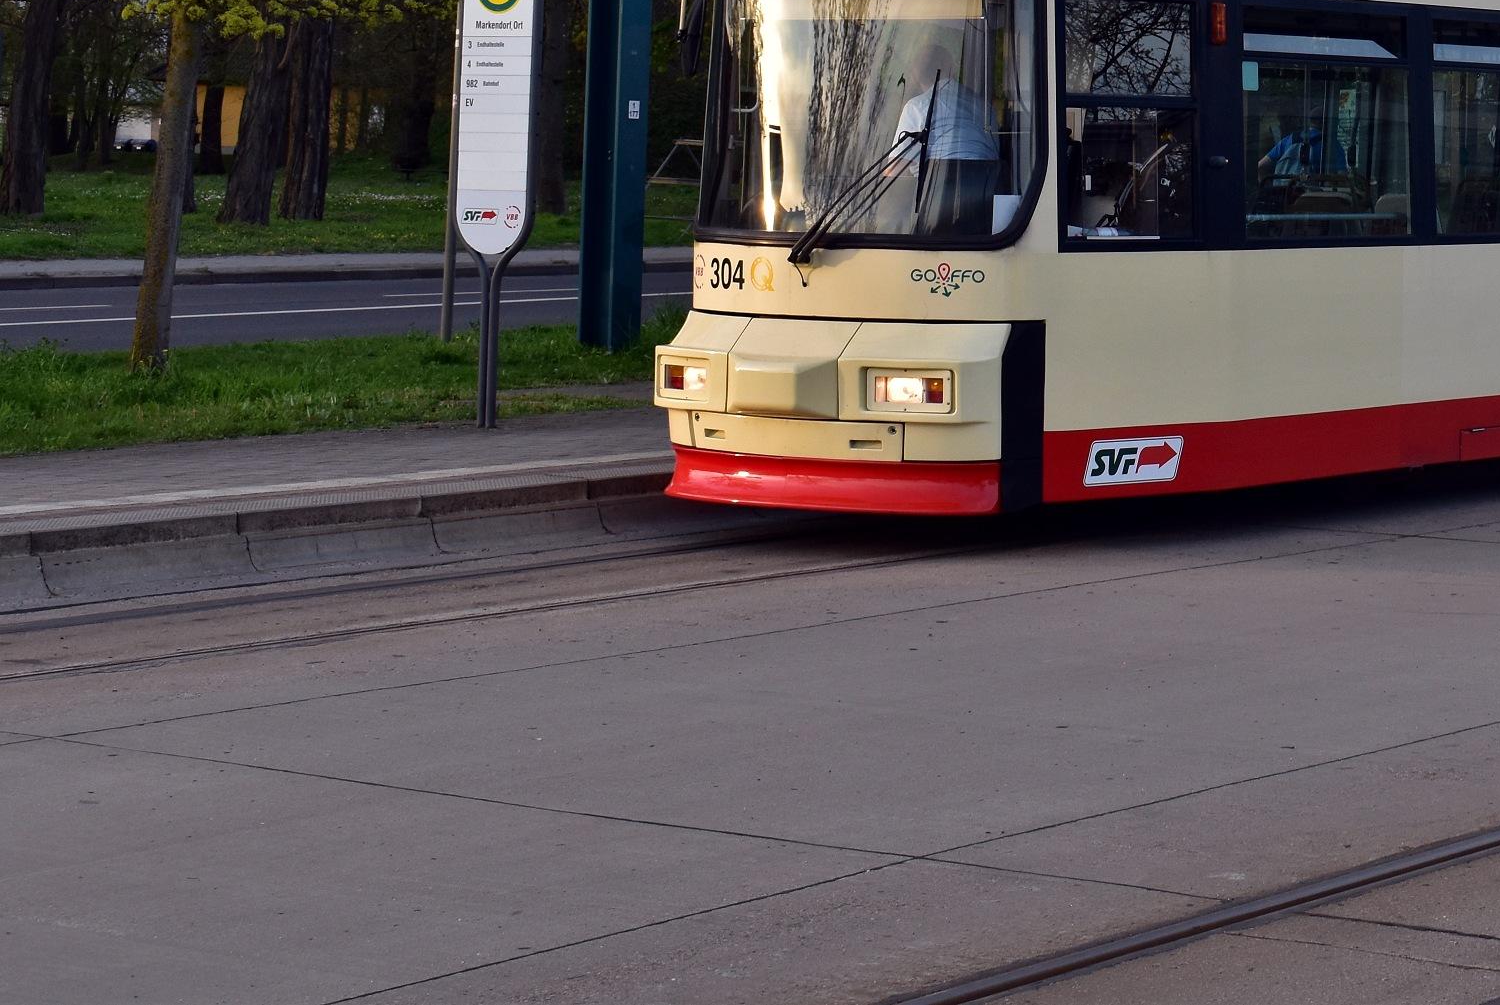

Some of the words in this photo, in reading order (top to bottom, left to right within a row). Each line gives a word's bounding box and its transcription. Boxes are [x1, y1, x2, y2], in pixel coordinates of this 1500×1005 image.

[513, 20, 523, 30] Ort
[467, 41, 473, 49] 3
[467, 60, 472, 69] 4
[466, 79, 478, 88] 982
[465, 98, 474, 107] EV
[463, 211, 482, 221] SVF
[710, 257, 746, 290] 304
[910, 268, 937, 282] GO
[951, 269, 985, 284] FFO
[1090, 447, 1138, 476] SVF
